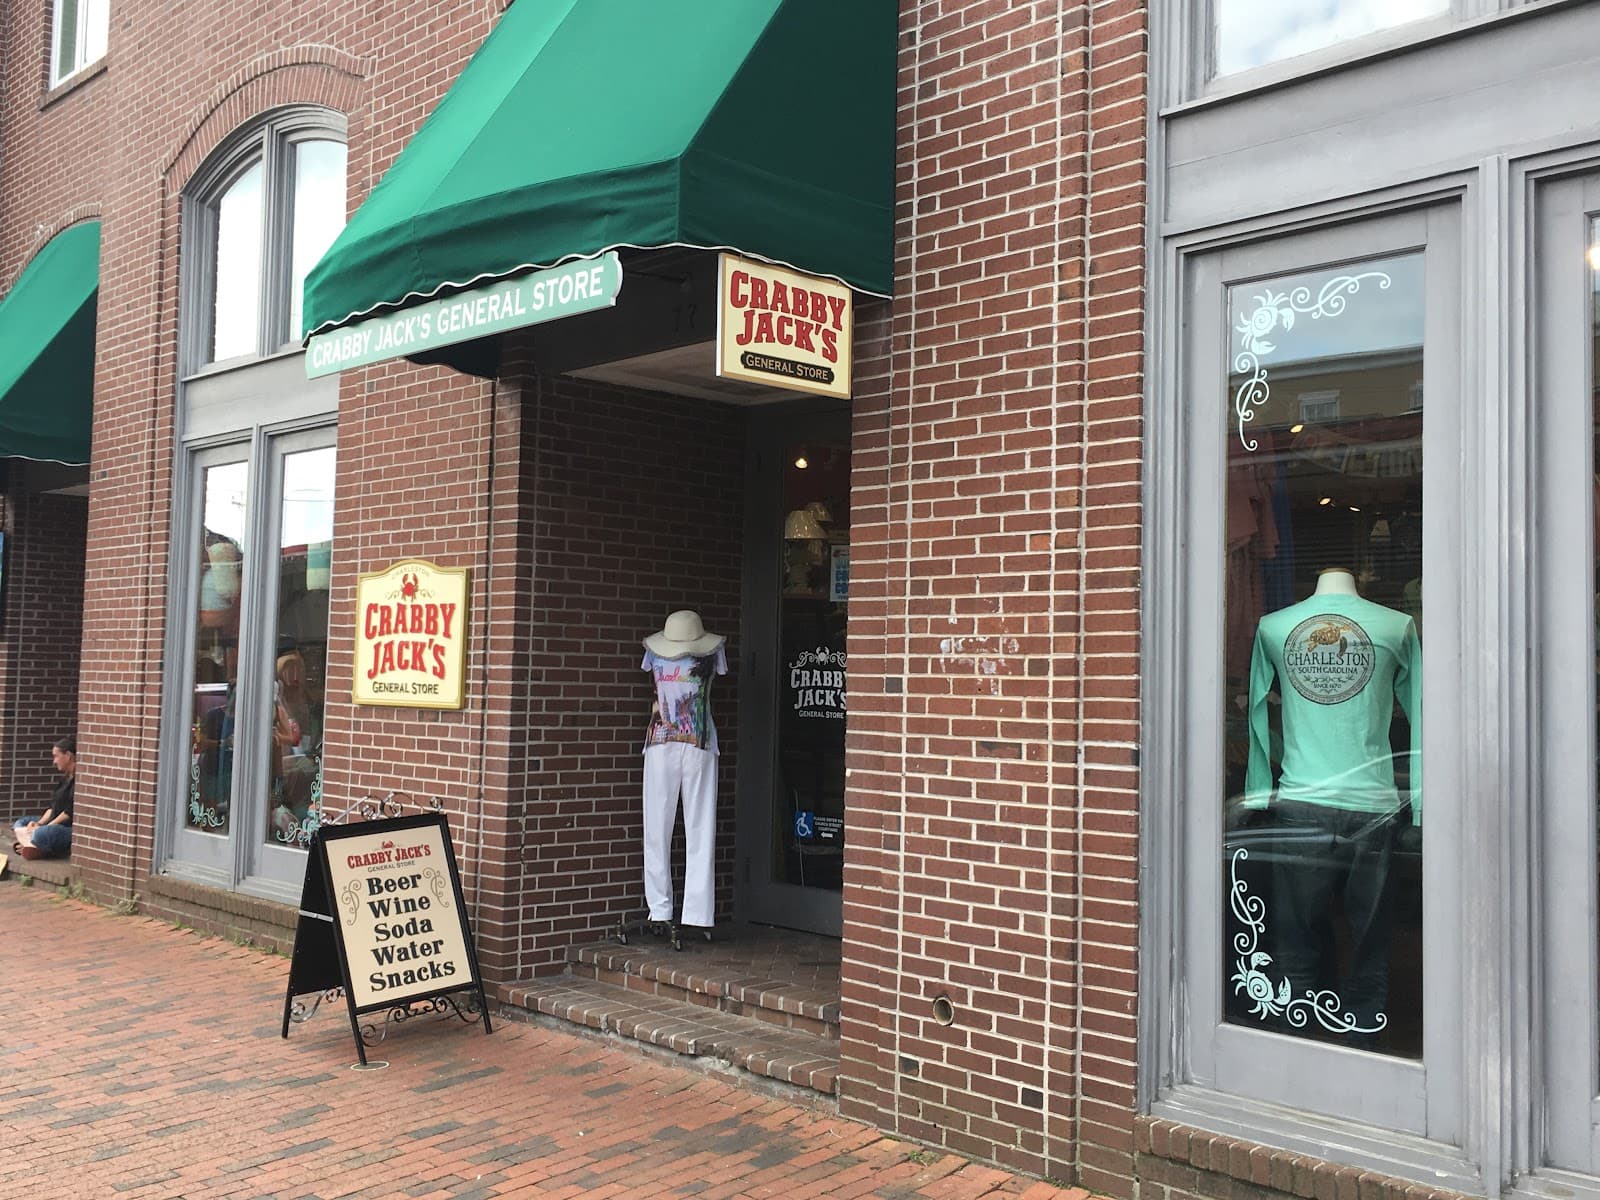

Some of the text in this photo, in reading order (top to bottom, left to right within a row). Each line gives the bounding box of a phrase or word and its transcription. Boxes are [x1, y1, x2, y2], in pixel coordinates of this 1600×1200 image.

[730, 270, 846, 332] CRABBY
[312, 266, 604, 368] CRABBY JACK'S GENERAL STORE
[736, 309, 838, 364] JACK'S
[746, 354, 829, 380] GENERAL STORE
[364, 602, 456, 640] CRABBY
[367, 638, 446, 680] JACK'S
[1287, 651, 1370, 666] CHARLESTON
[1298, 666, 1358, 674] SOUTH CAROLINA
[372, 681, 439, 695] GENERAL STORE
[793, 689, 847, 710] JACK'S
[798, 710, 844, 719] GENERAL STORE
[347, 844, 432, 869] CRABBY JACK'S
[367, 860, 416, 873] GENERAL STORE
[366, 873, 422, 896] Beer
[367, 895, 431, 919] Wine
[374, 917, 434, 942] Soda
[370, 939, 444, 966] Water
[369, 960, 456, 992] Snacks
